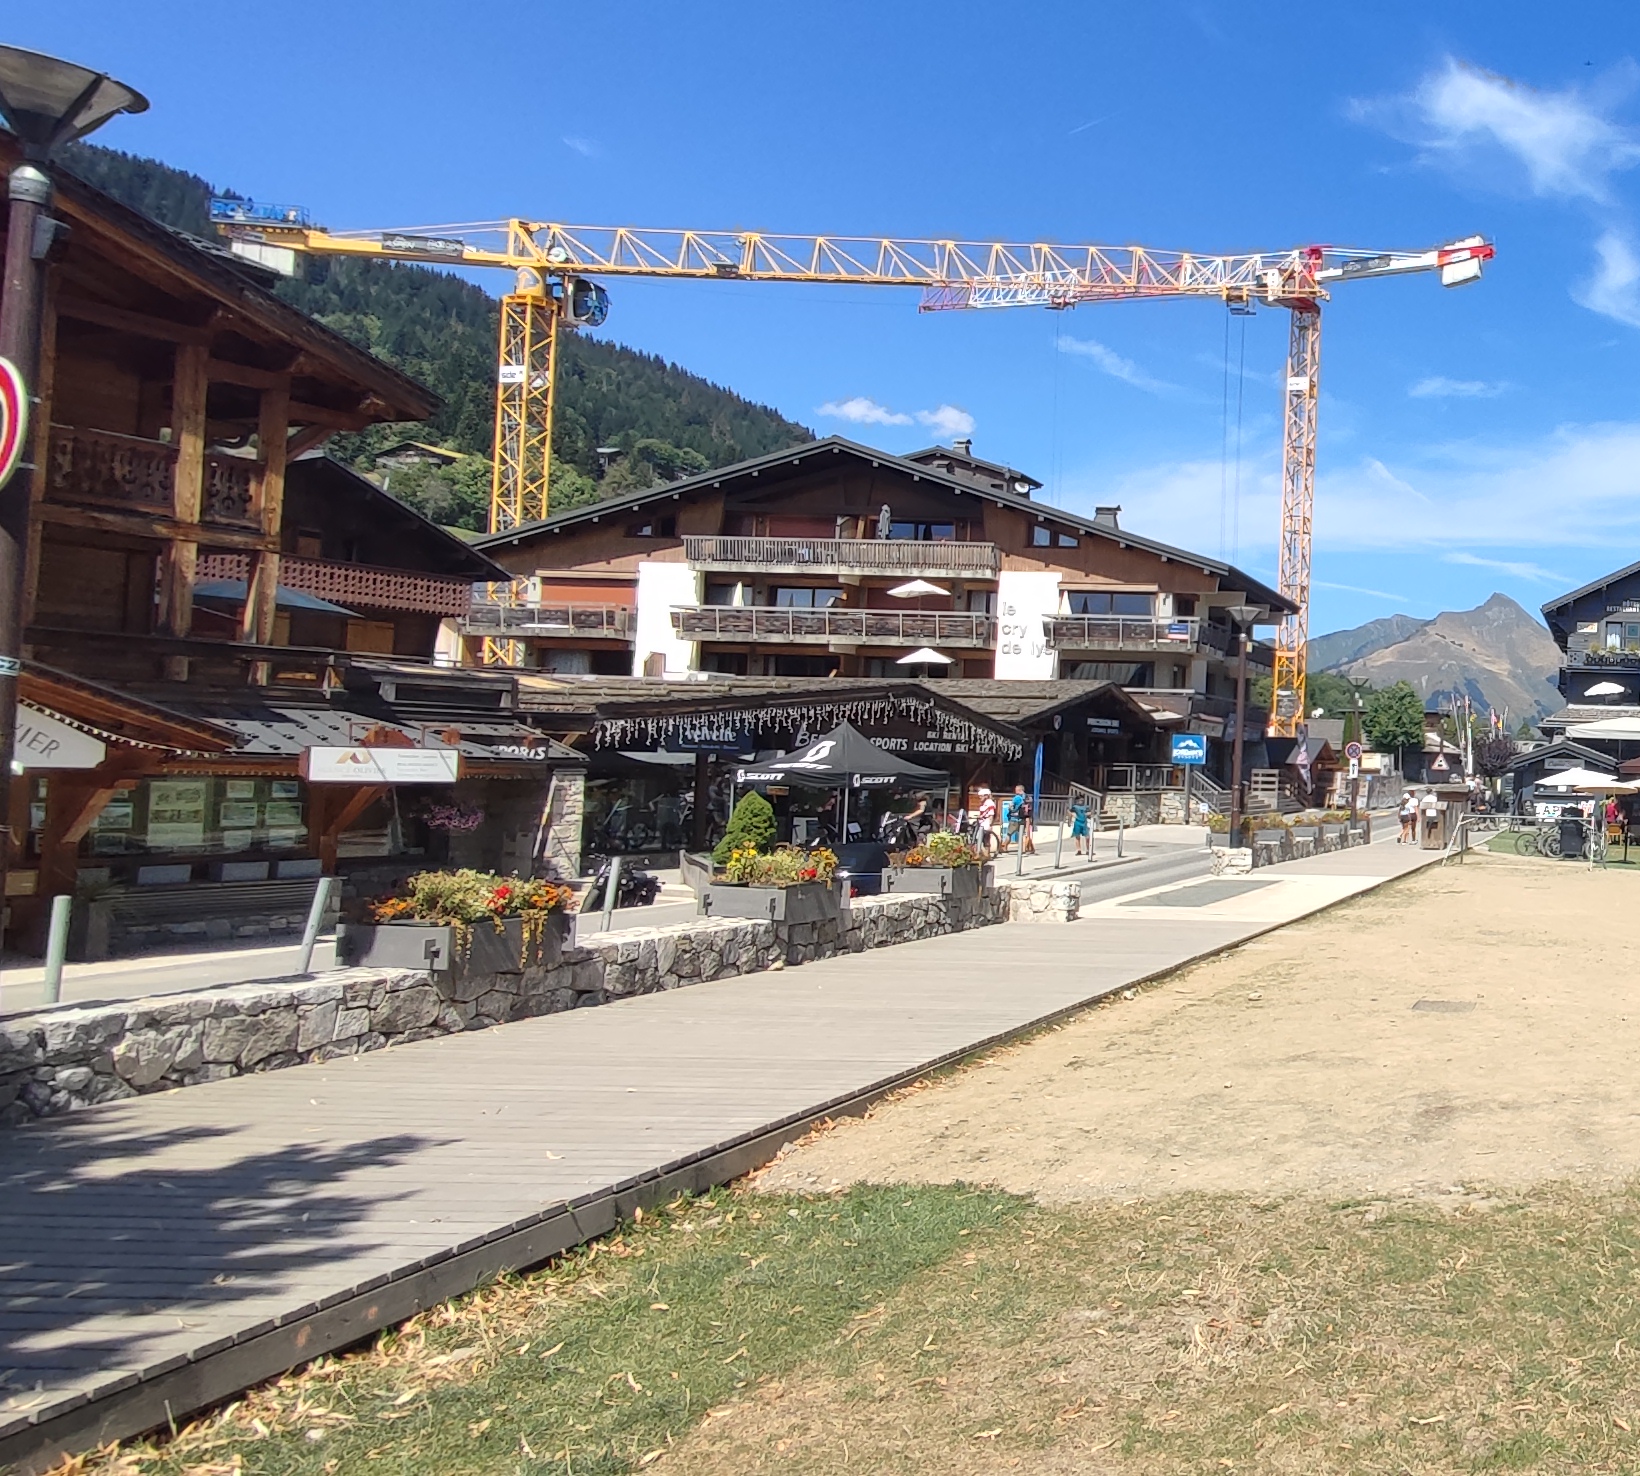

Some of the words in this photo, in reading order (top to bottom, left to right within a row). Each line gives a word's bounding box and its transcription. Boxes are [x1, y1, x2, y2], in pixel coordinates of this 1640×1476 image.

[1002, 602, 1016, 616] le
[1002, 624, 1027, 639] cry
[1002, 641, 1021, 655] de
[14, 723, 60, 758] IER
[870, 737, 908, 751] SPORTS
[913, 742, 952, 753] LOCATION
[955, 743, 968, 753] SKI
[745, 772, 785, 780] SCOTT
[860, 776, 897, 784] SCOTT
